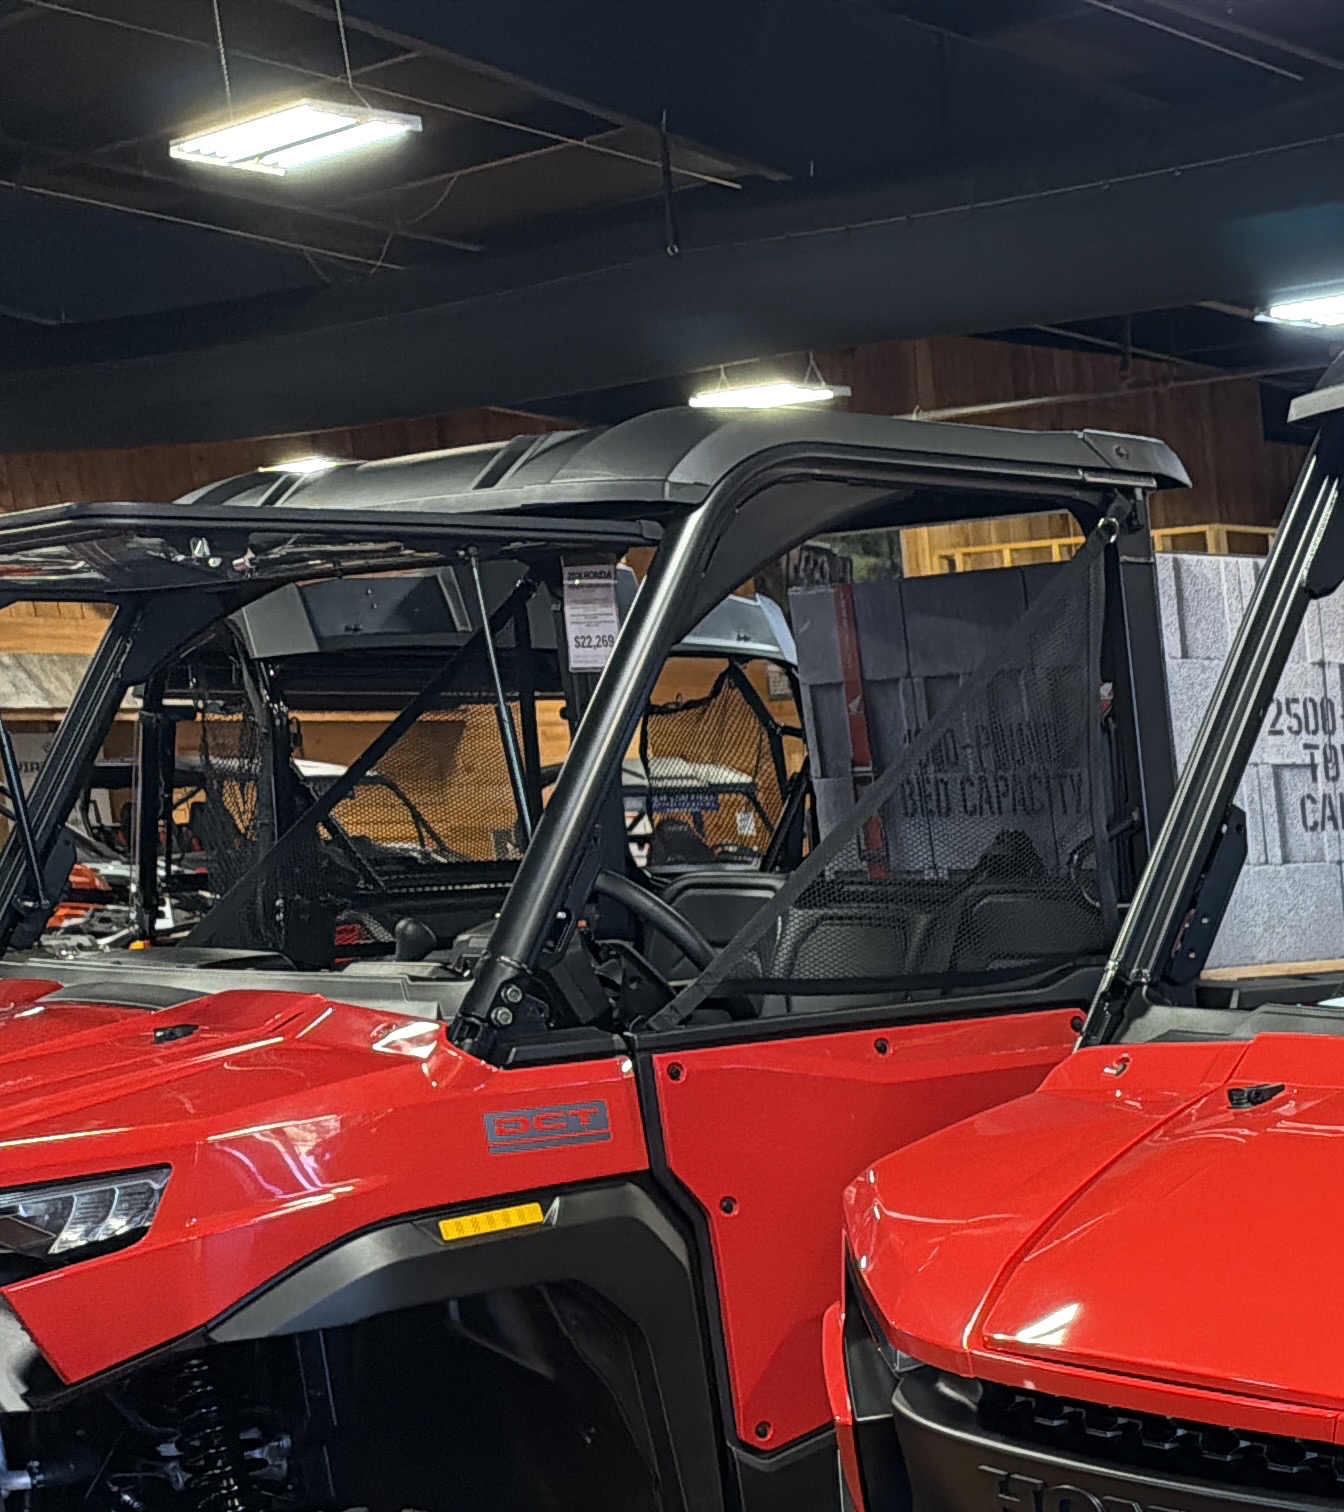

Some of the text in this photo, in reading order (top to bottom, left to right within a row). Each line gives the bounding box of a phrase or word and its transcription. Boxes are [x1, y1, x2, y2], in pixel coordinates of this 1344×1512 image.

[574, 634, 615, 650] $22,269
[901, 772, 1083, 817] BED CAPACITY
[494, 1107, 599, 1136] DCT
